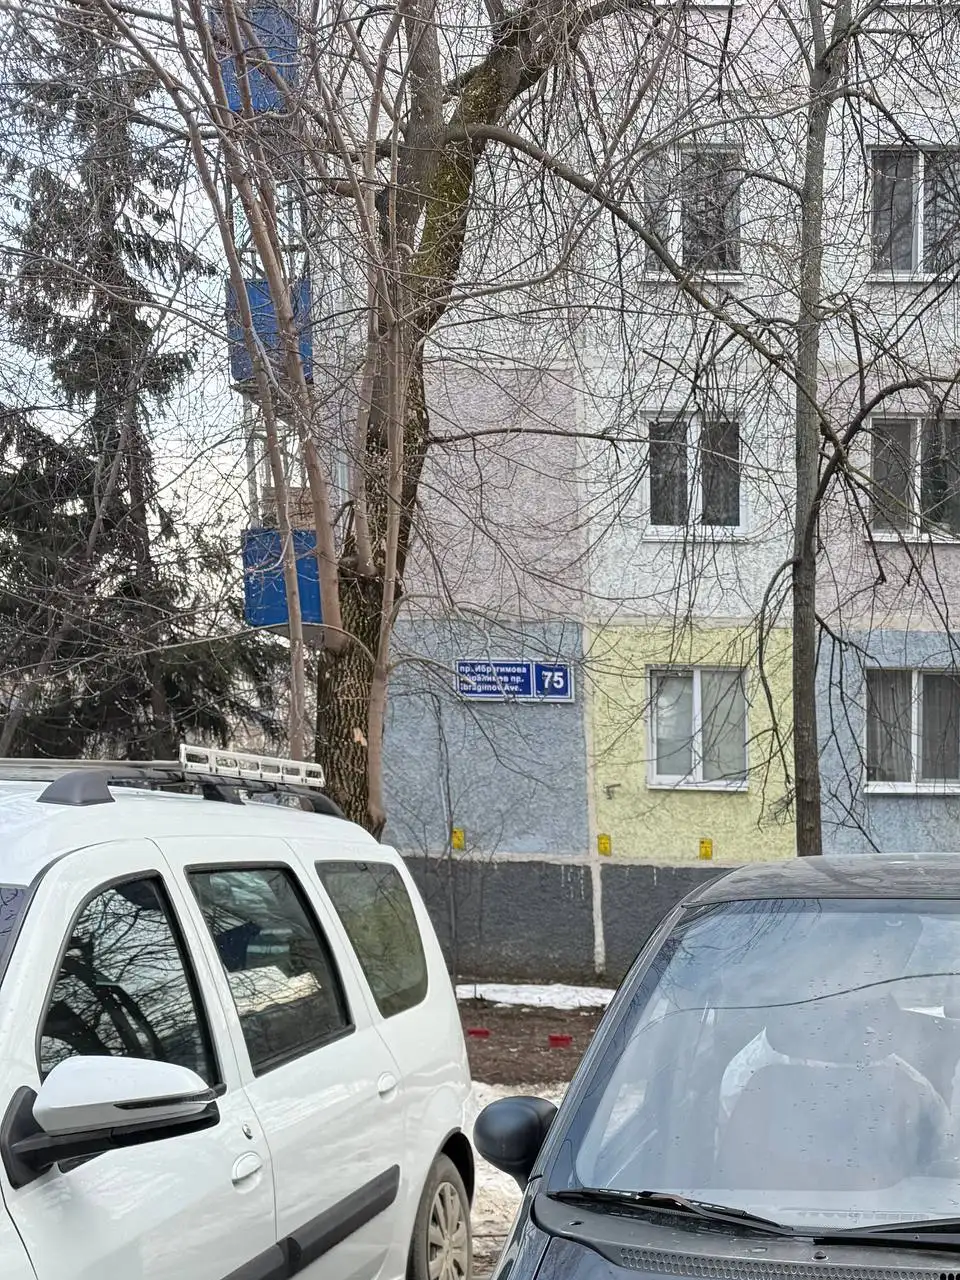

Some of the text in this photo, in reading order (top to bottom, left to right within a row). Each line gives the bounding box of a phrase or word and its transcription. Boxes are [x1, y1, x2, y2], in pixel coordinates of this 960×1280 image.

[475, 664, 527, 674] Ибргимова
[510, 675, 525, 685] пр.
[541, 670, 565, 689] 75
[504, 683, 523, 692] Ave.
